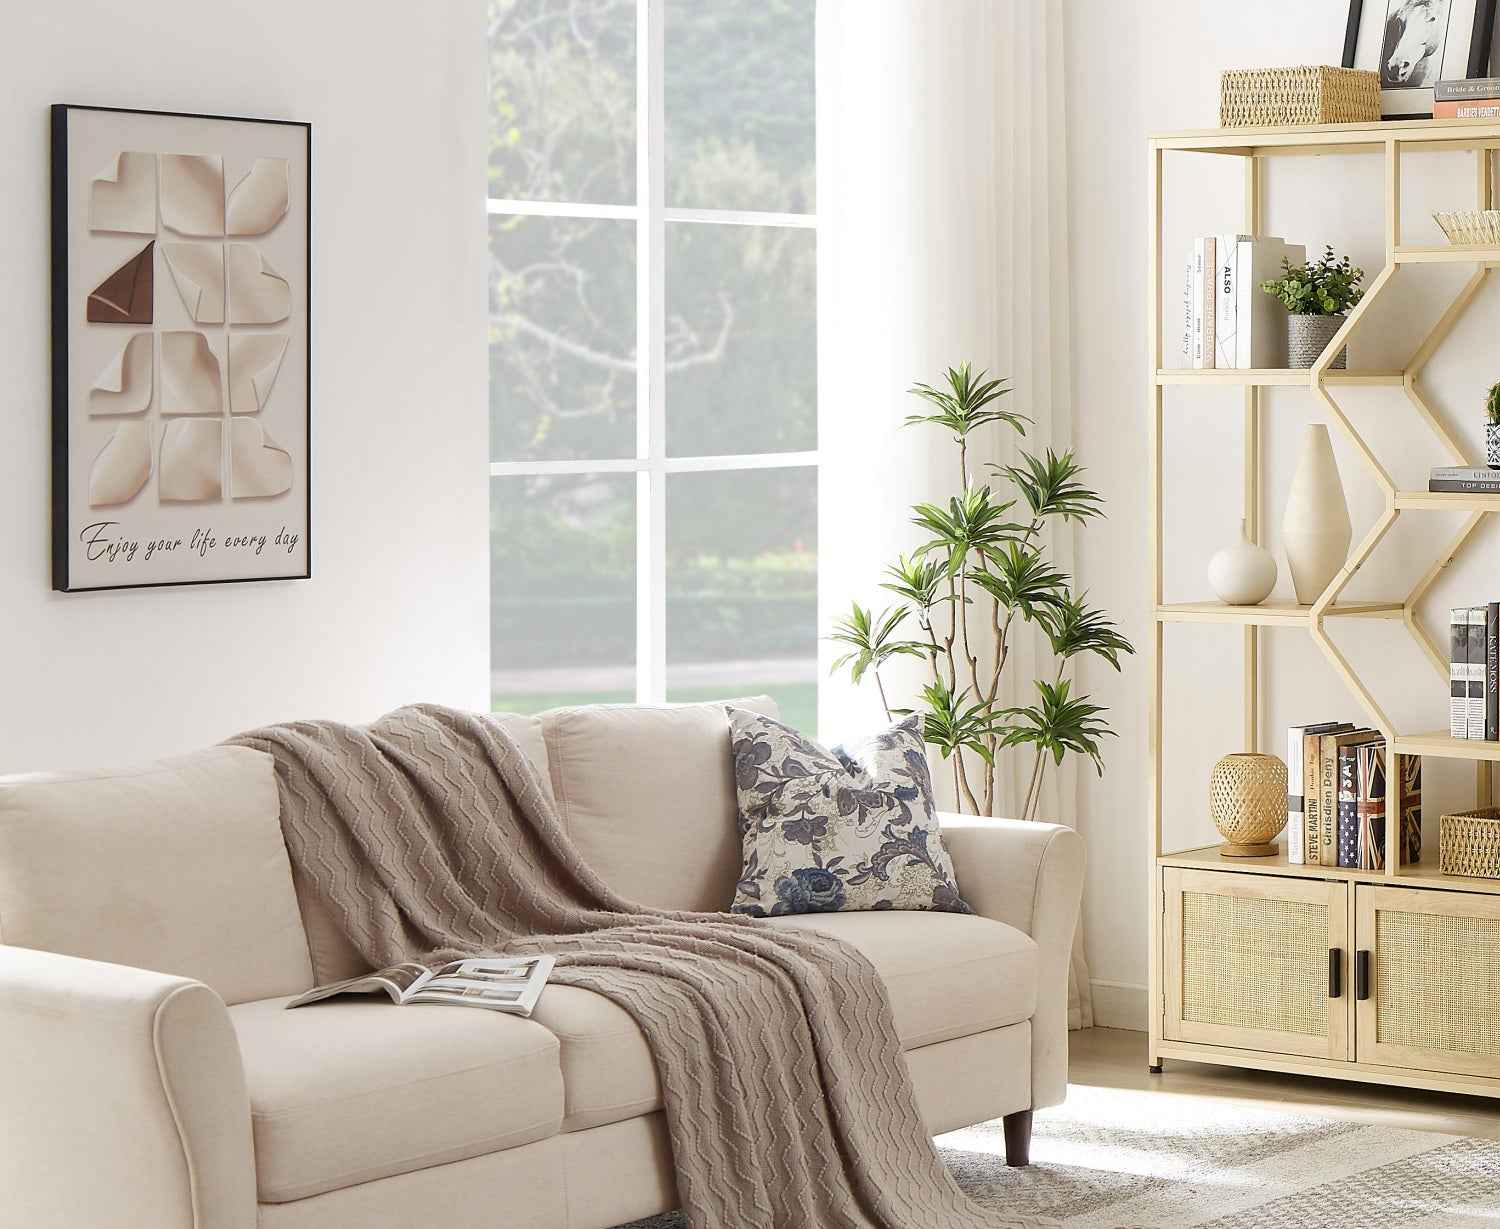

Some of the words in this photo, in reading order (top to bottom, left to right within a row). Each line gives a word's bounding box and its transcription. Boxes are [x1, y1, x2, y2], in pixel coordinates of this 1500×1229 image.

[1223, 266, 1231, 294] ALSO
[80, 521, 138, 562] Enjoy
[144, 540, 182, 561] your
[190, 528, 217, 557] life
[224, 534, 267, 555] every
[274, 526, 299, 554] day
[1323, 757, 1334, 787] Deny
[1308, 798, 1318, 832] MARTINI
[1323, 791, 1332, 846] Chrisdien
[1309, 834, 1318, 861] STEVE
